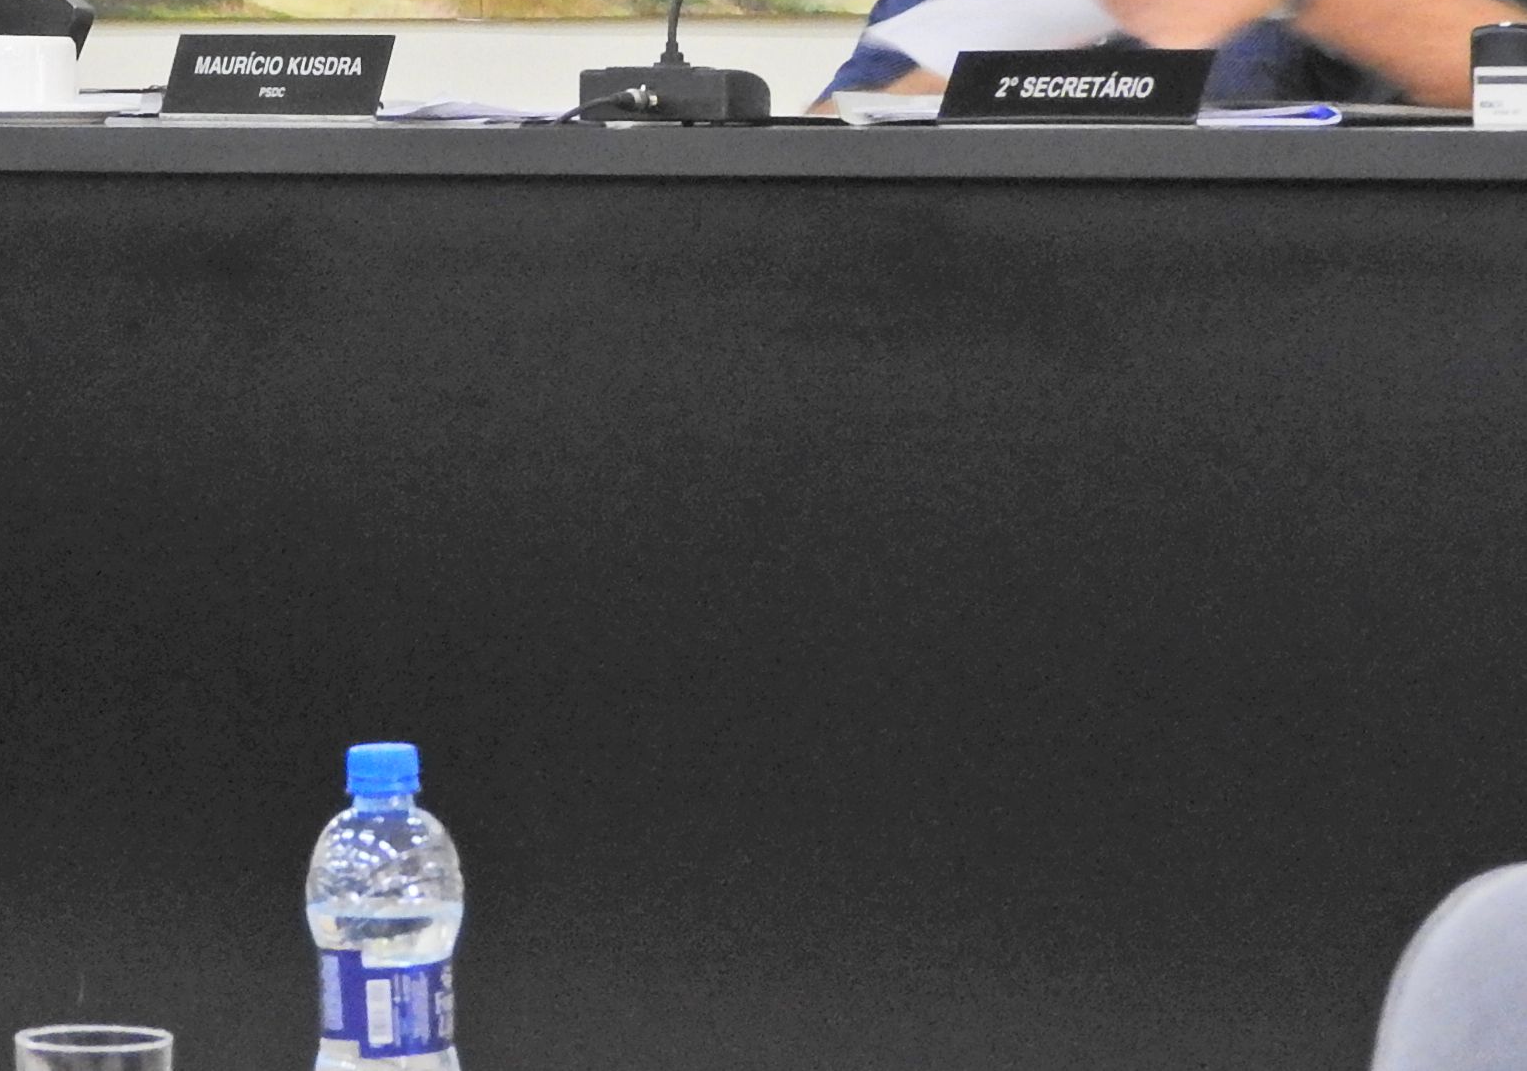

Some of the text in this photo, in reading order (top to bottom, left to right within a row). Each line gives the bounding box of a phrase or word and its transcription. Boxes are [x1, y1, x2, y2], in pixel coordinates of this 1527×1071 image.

[194, 51, 362, 76] MAURÍCIO KUSDRA
[258, 86, 287, 98] PSDC
[1020, 71, 1155, 98] SECRETÁRIO
